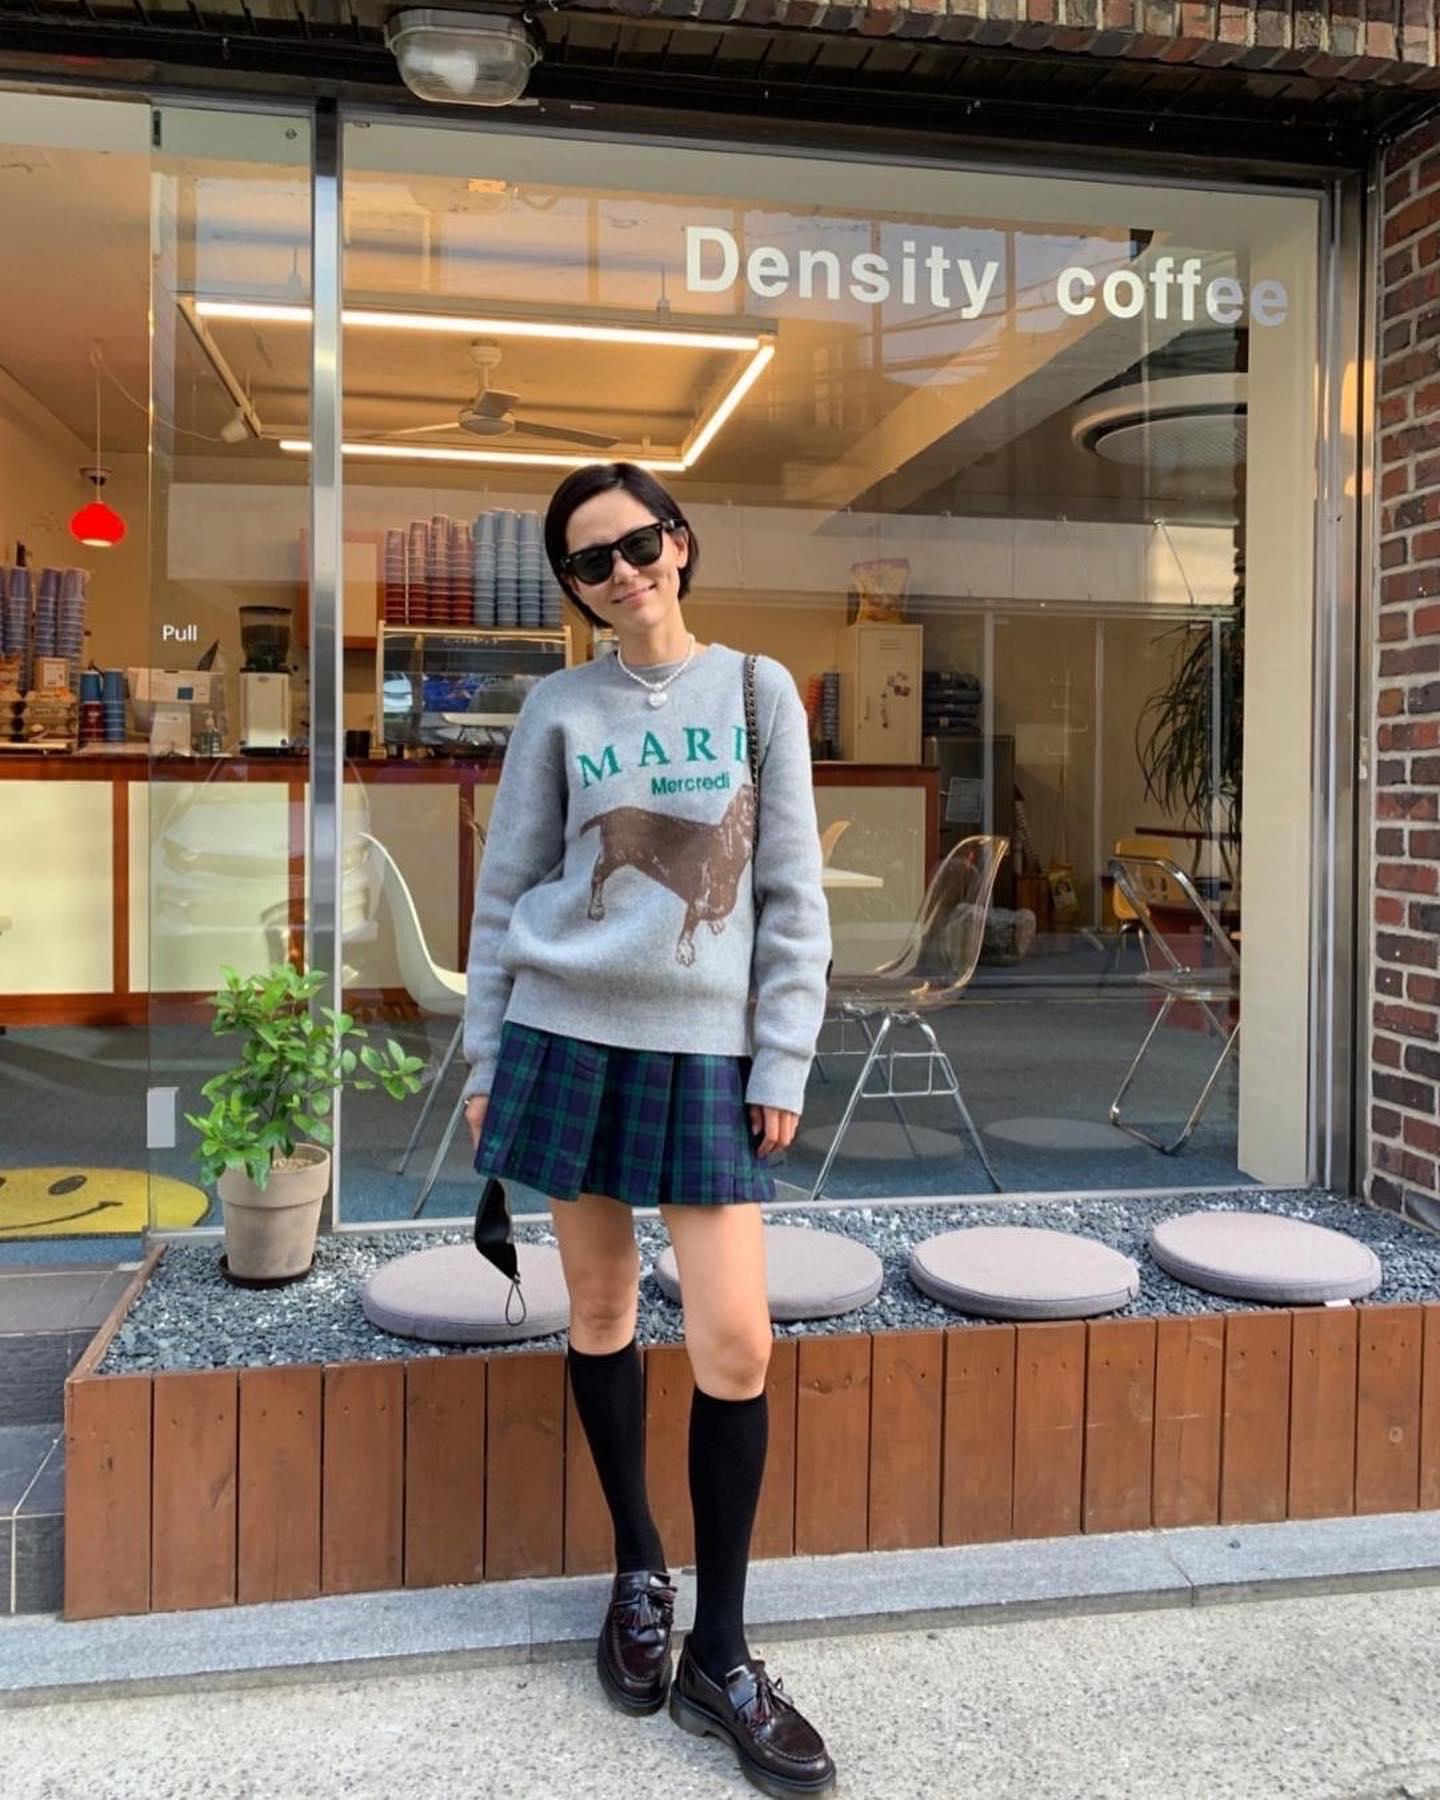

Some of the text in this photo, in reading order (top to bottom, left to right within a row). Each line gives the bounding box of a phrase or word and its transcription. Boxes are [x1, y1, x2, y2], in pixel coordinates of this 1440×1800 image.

[686, 225, 1289, 327] Density coffee
[162, 624, 198, 641] Pull
[651, 772, 731, 796] Mercredi
